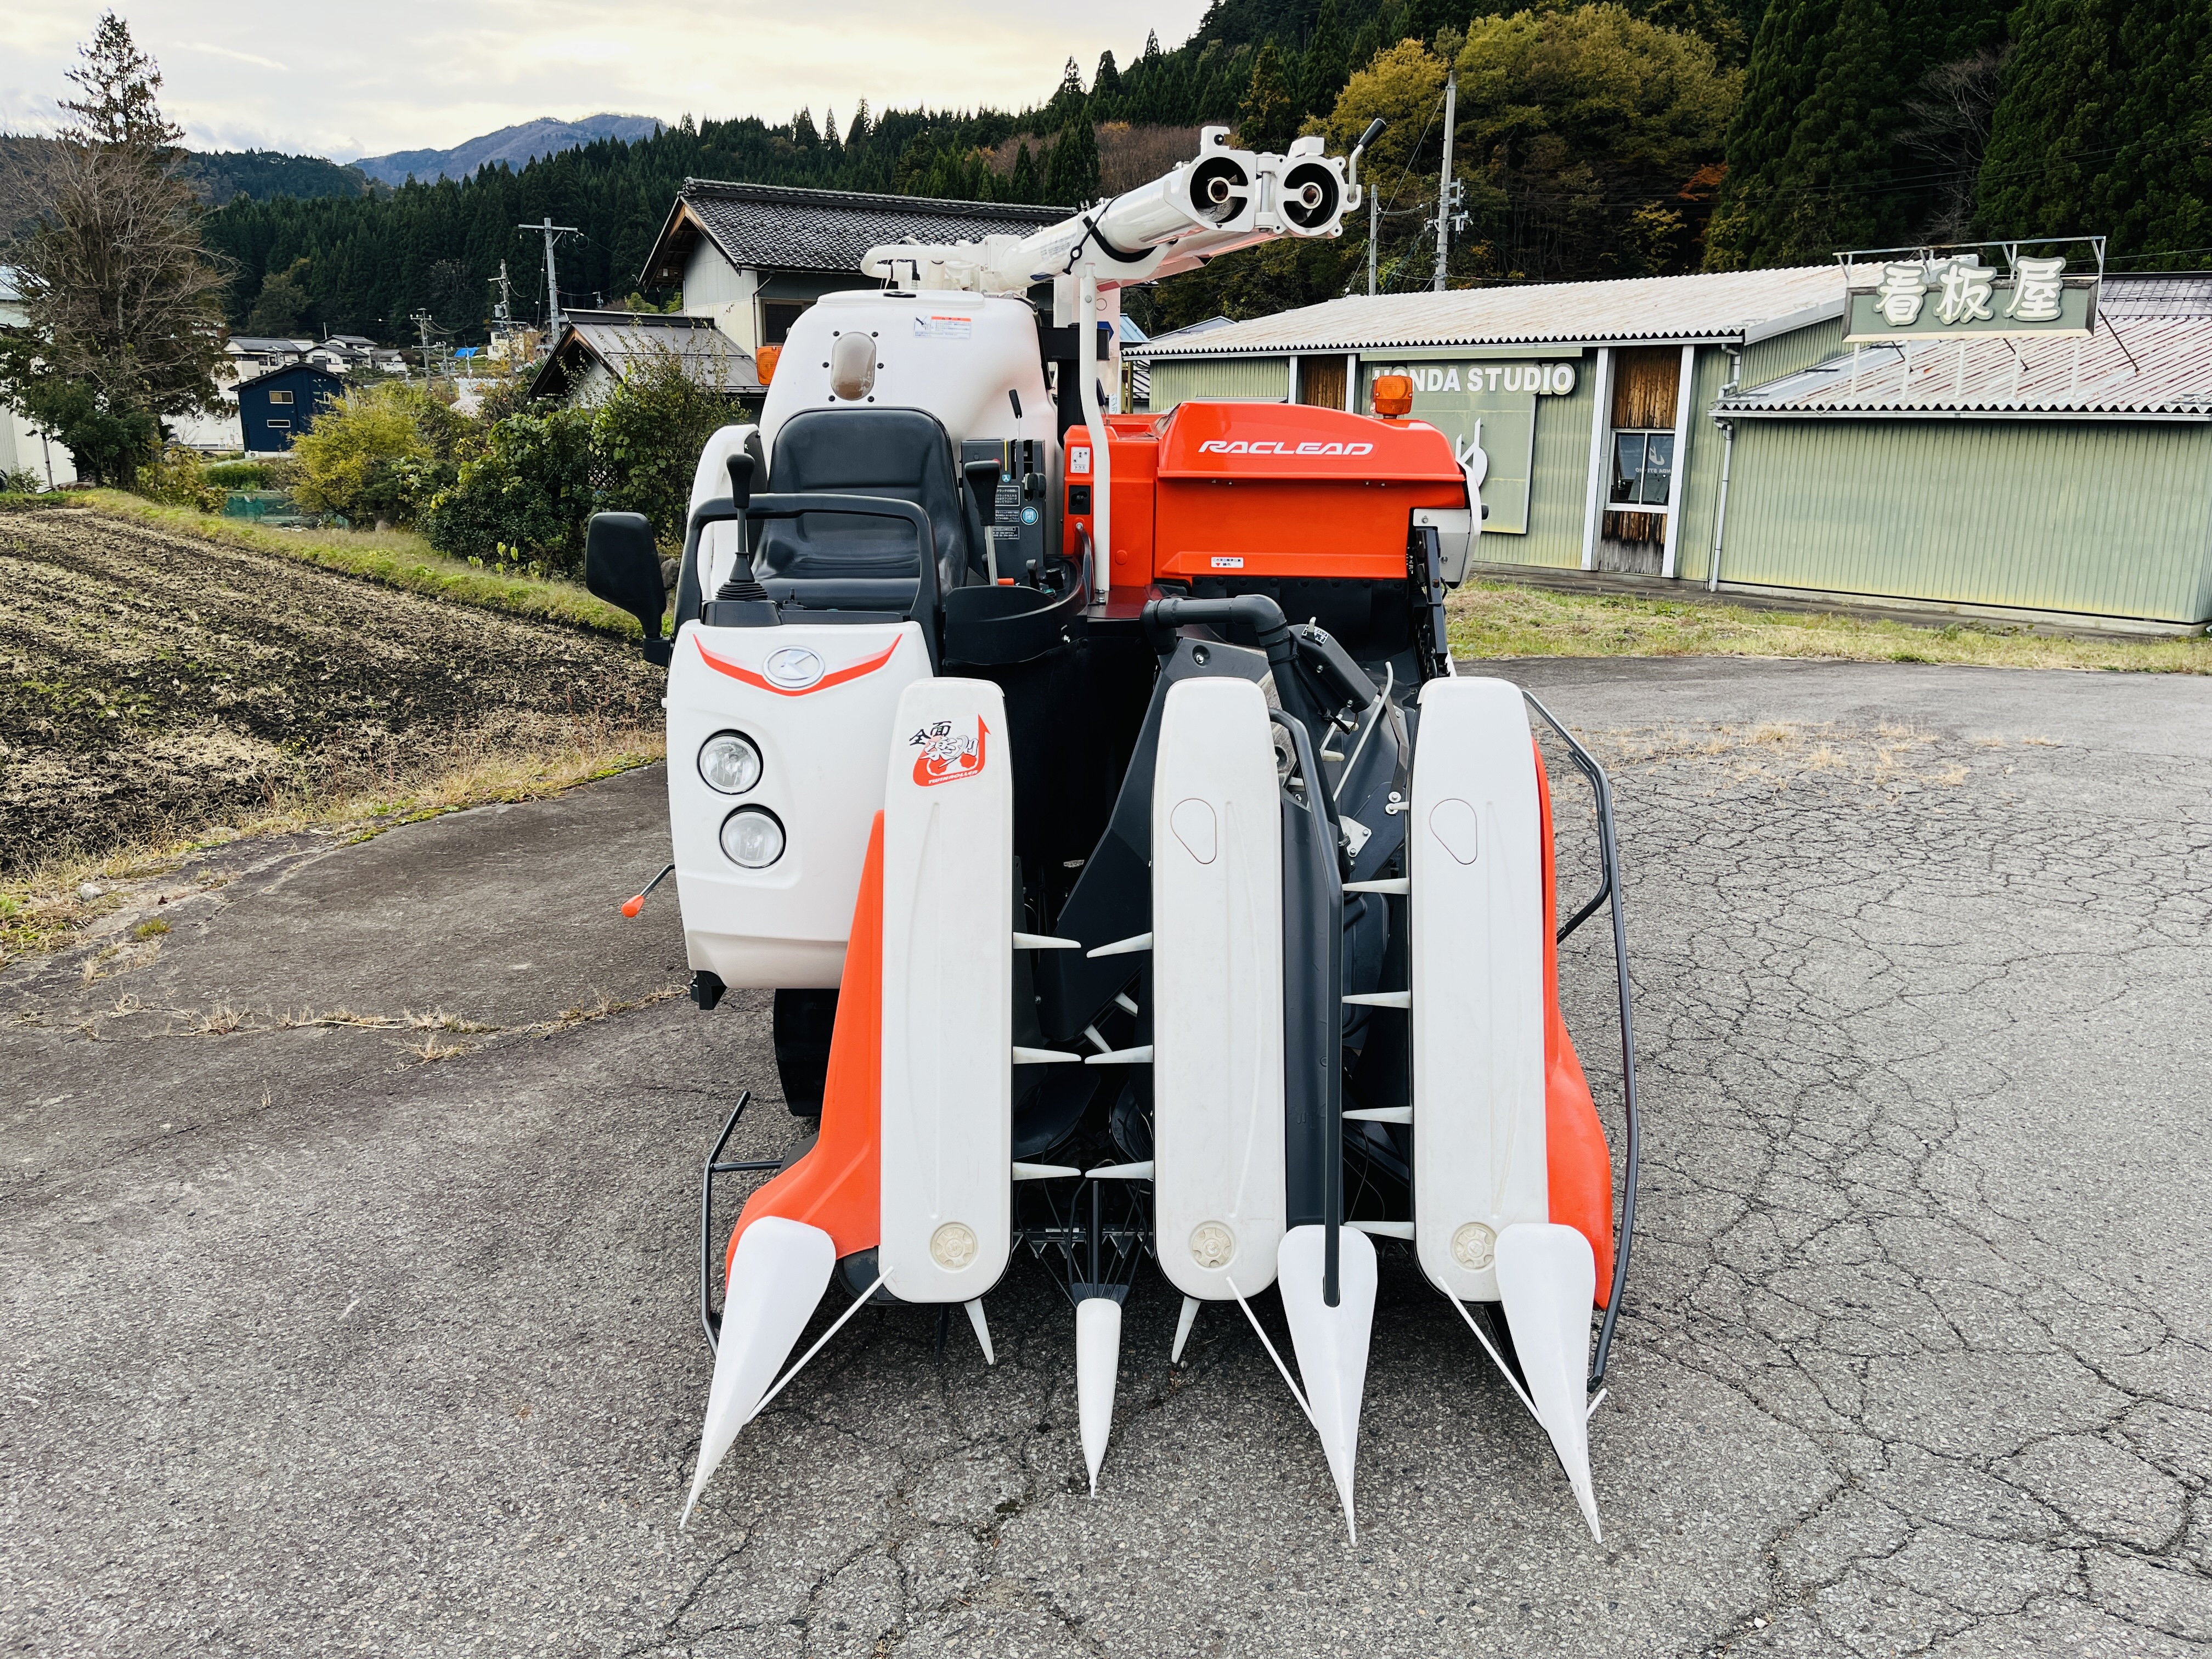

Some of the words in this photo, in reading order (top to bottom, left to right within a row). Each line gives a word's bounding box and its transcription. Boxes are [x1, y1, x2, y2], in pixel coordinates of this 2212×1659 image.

[1875, 259, 2064, 324] 看板屋
[1466, 366, 1573, 392] STUDIO
[1198, 441, 1373, 455] RACLEAD
[909, 721, 952, 746] 全面
